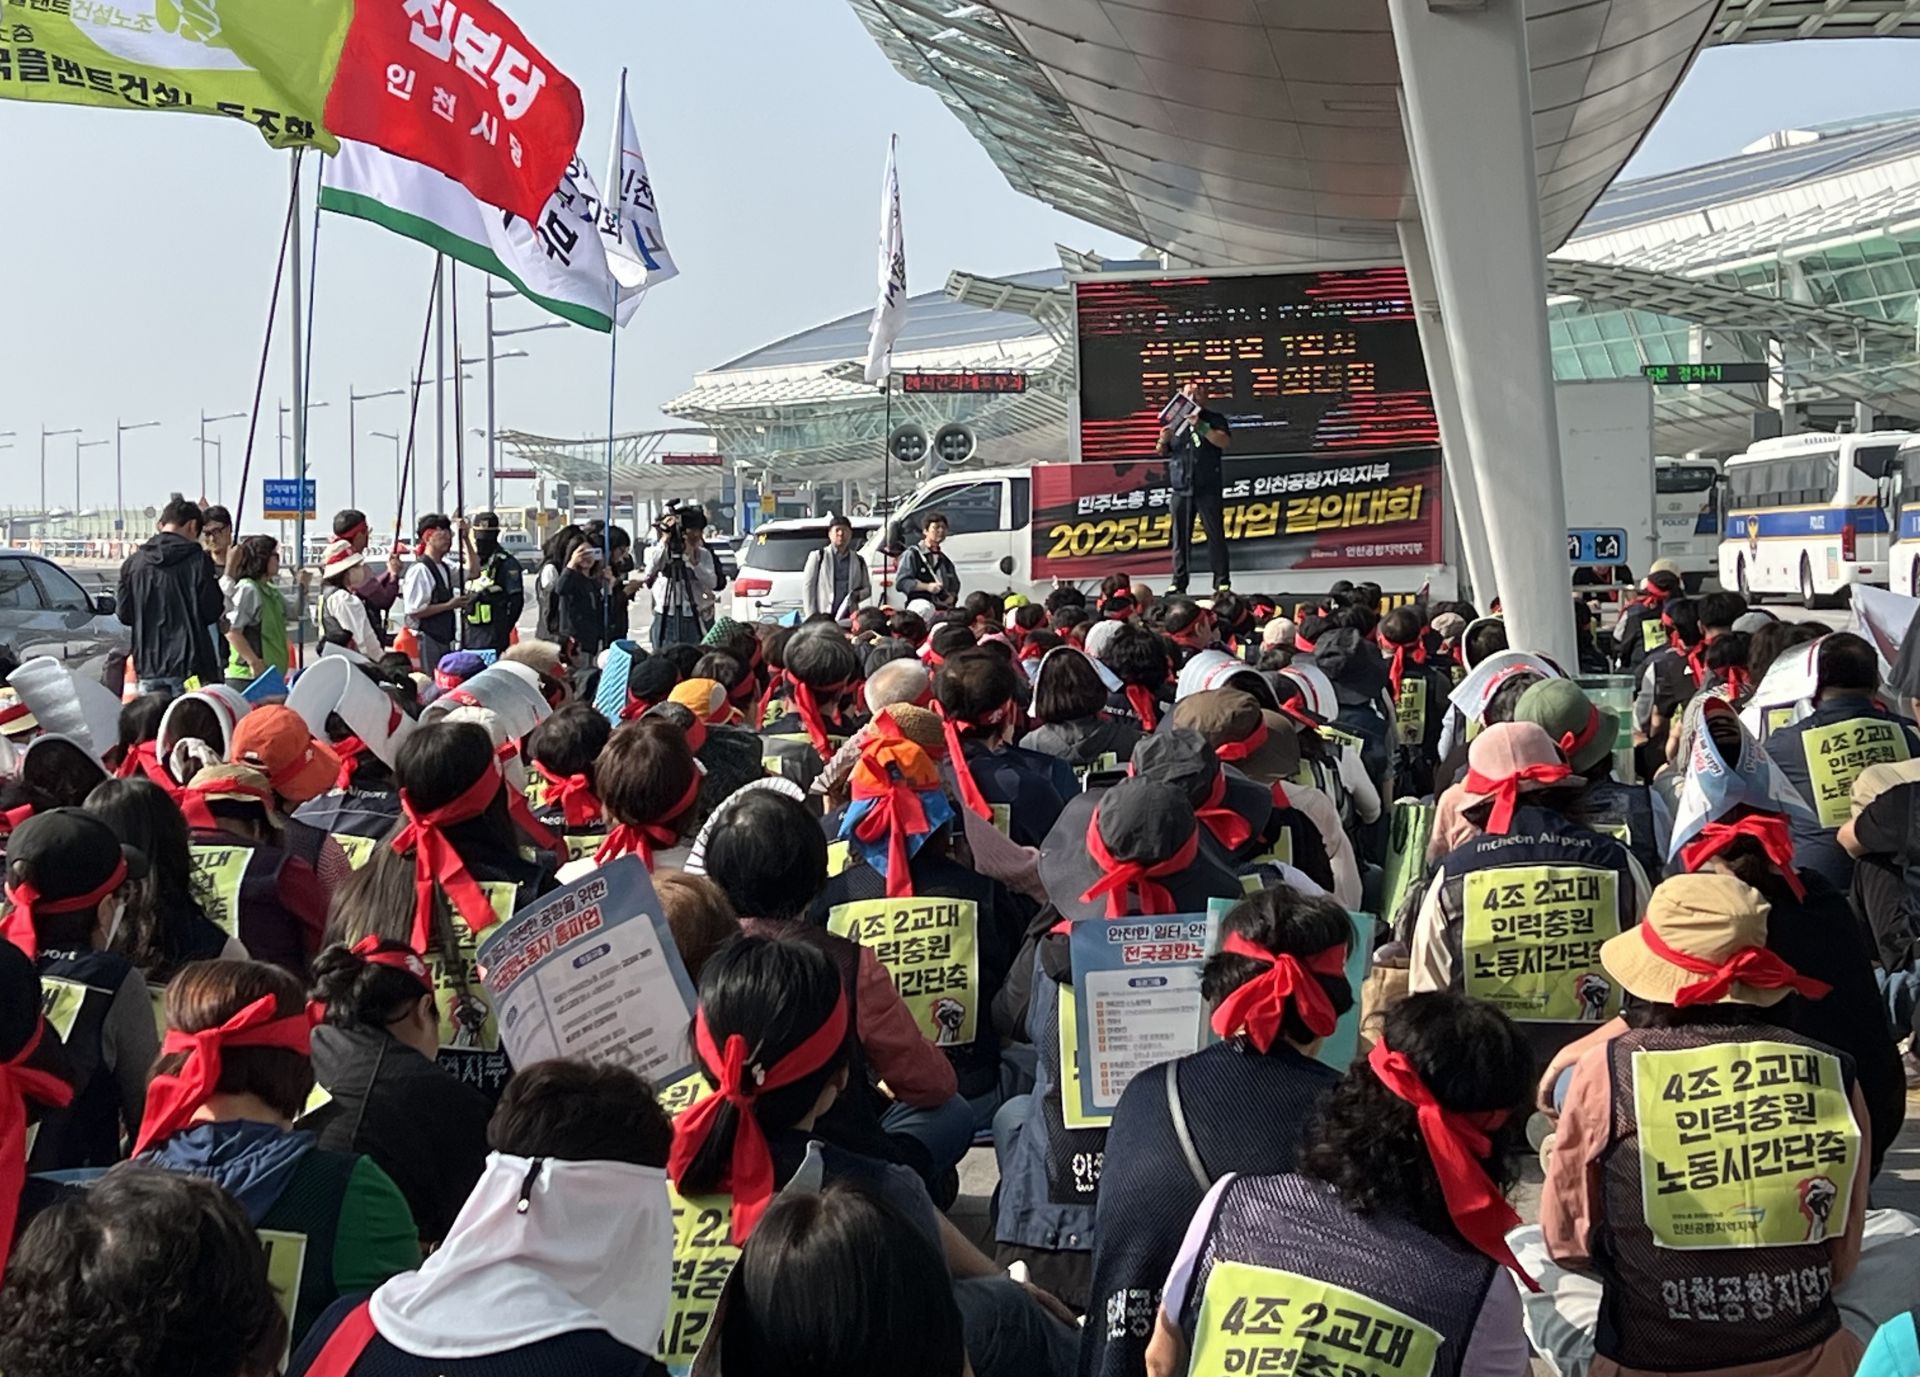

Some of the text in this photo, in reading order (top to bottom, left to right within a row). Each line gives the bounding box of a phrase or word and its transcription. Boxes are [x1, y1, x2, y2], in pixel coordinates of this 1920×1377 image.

[402, 0, 546, 120] 진보당
[1077, 489, 1146, 515] 민주노총
[1254, 462, 1391, 496] 인천공항지역지부
[1285, 484, 1423, 533] 결의대회
[1820, 732, 1851, 755] 4조
[1477, 832, 1593, 852] Incheon Airport
[1483, 876, 1600, 911] 4조 2교대
[847, 904, 959, 943] 4조 2교대
[1108, 926, 1150, 941] 안전한
[1490, 908, 1595, 944] 인력충원
[873, 934, 951, 966] 력충원
[1662, 1054, 1822, 1103] 4조 2교대
[1675, 1093, 1817, 1145] 인력충원
[1656, 1130, 1847, 1196] 노동시간단축
[1220, 1297, 1290, 1335] 4조
[1294, 1302, 1414, 1369] 2교대
